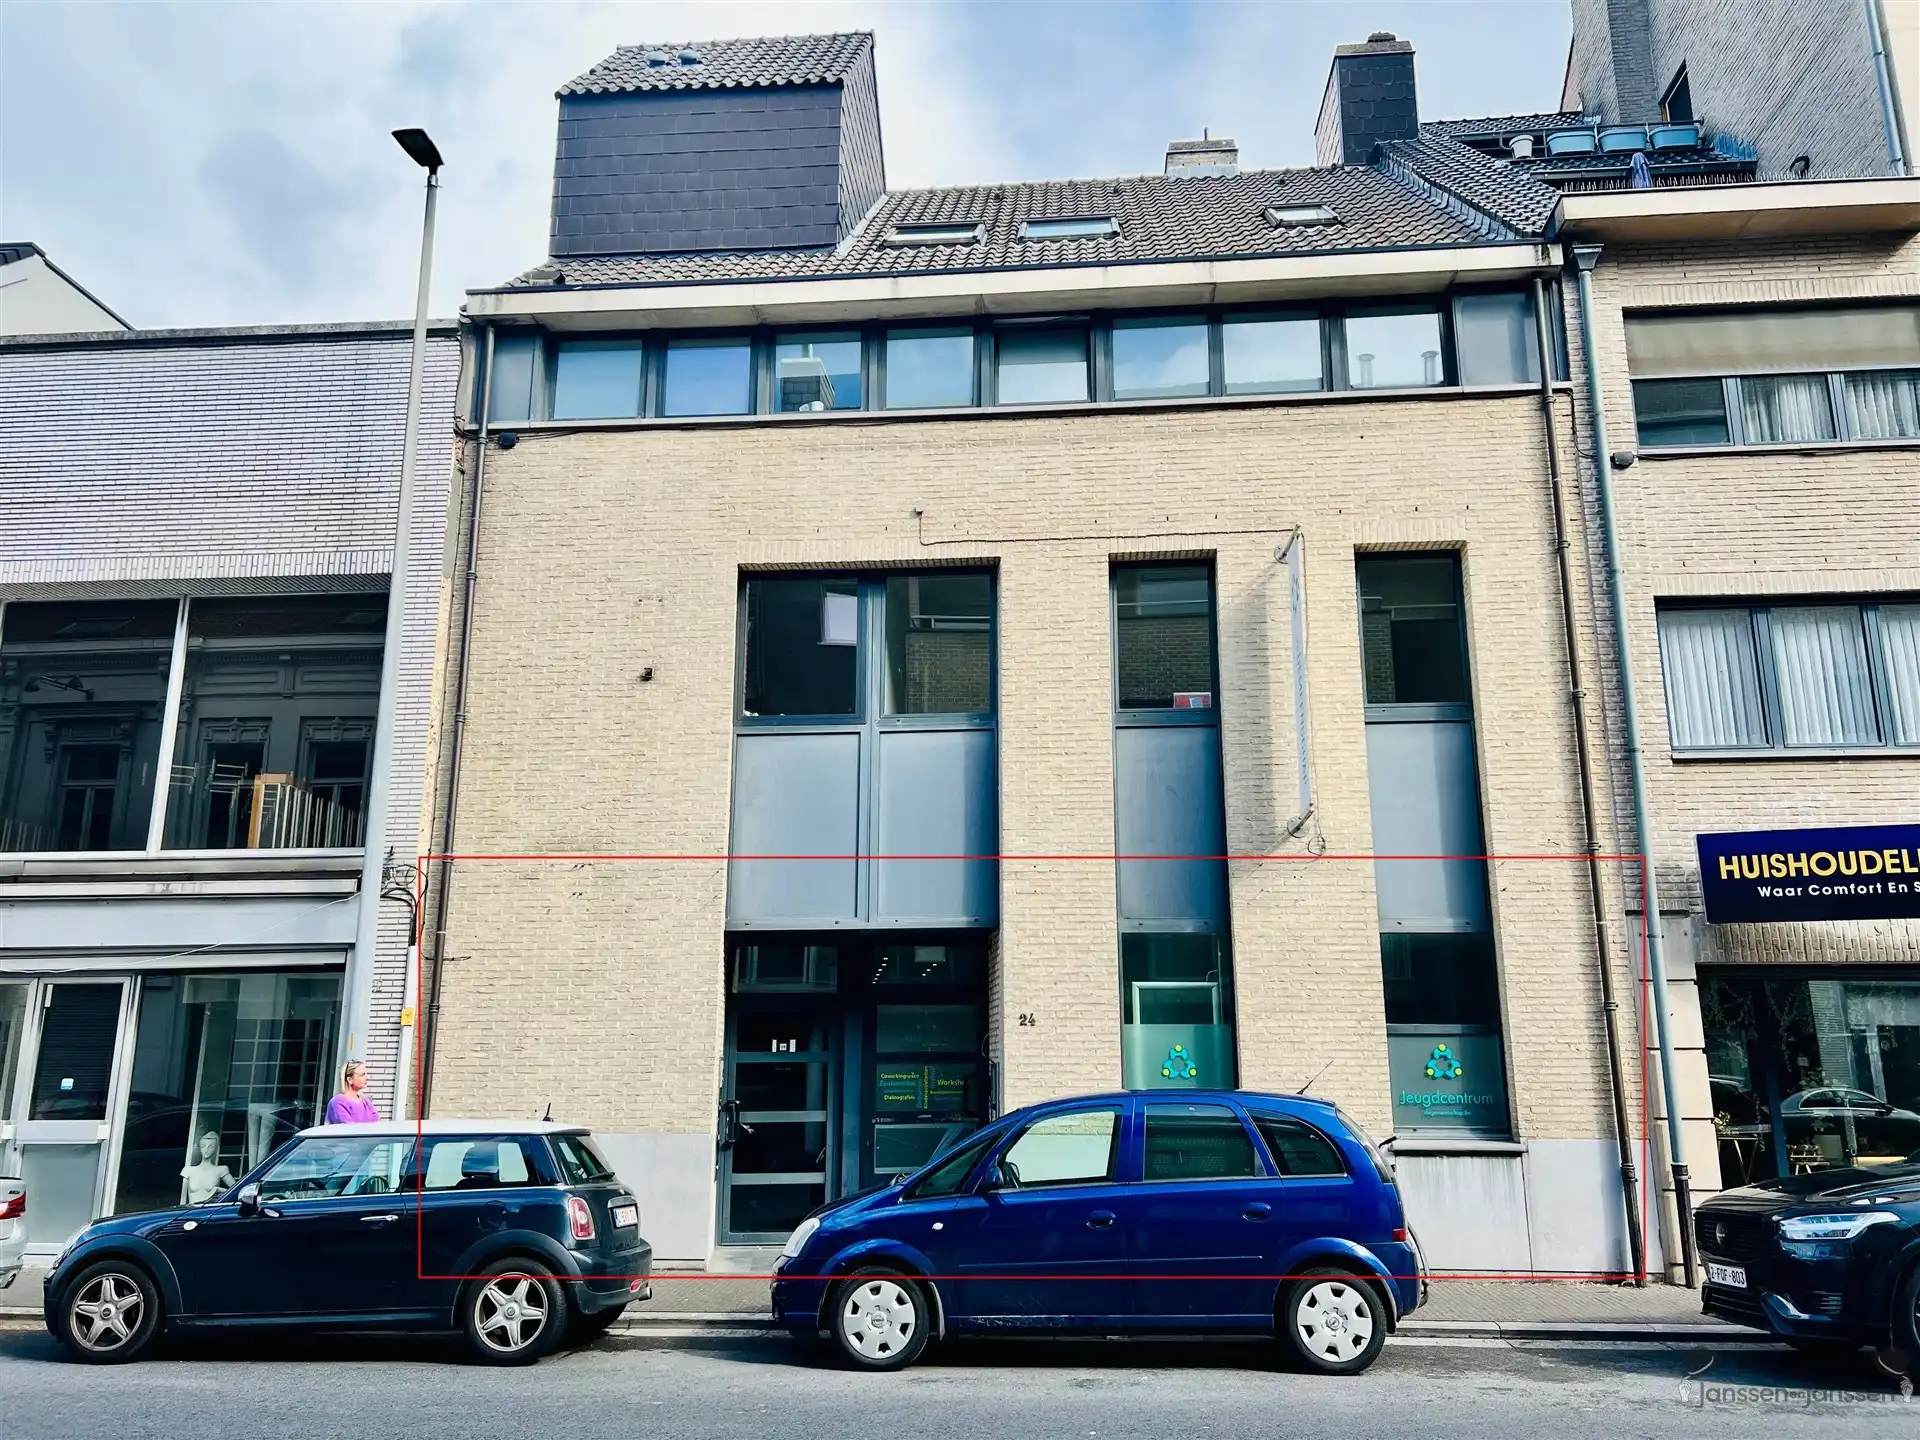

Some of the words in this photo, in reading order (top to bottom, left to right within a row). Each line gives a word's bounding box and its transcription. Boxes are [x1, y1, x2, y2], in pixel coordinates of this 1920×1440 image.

[1757, 886, 1803, 898] Waar
[1808, 881, 1883, 896] Comfort
[1888, 881, 1909, 894] En
[1019, 1012, 1036, 1027] 24
[1400, 1089, 1493, 1108] Jeugdcentrum
